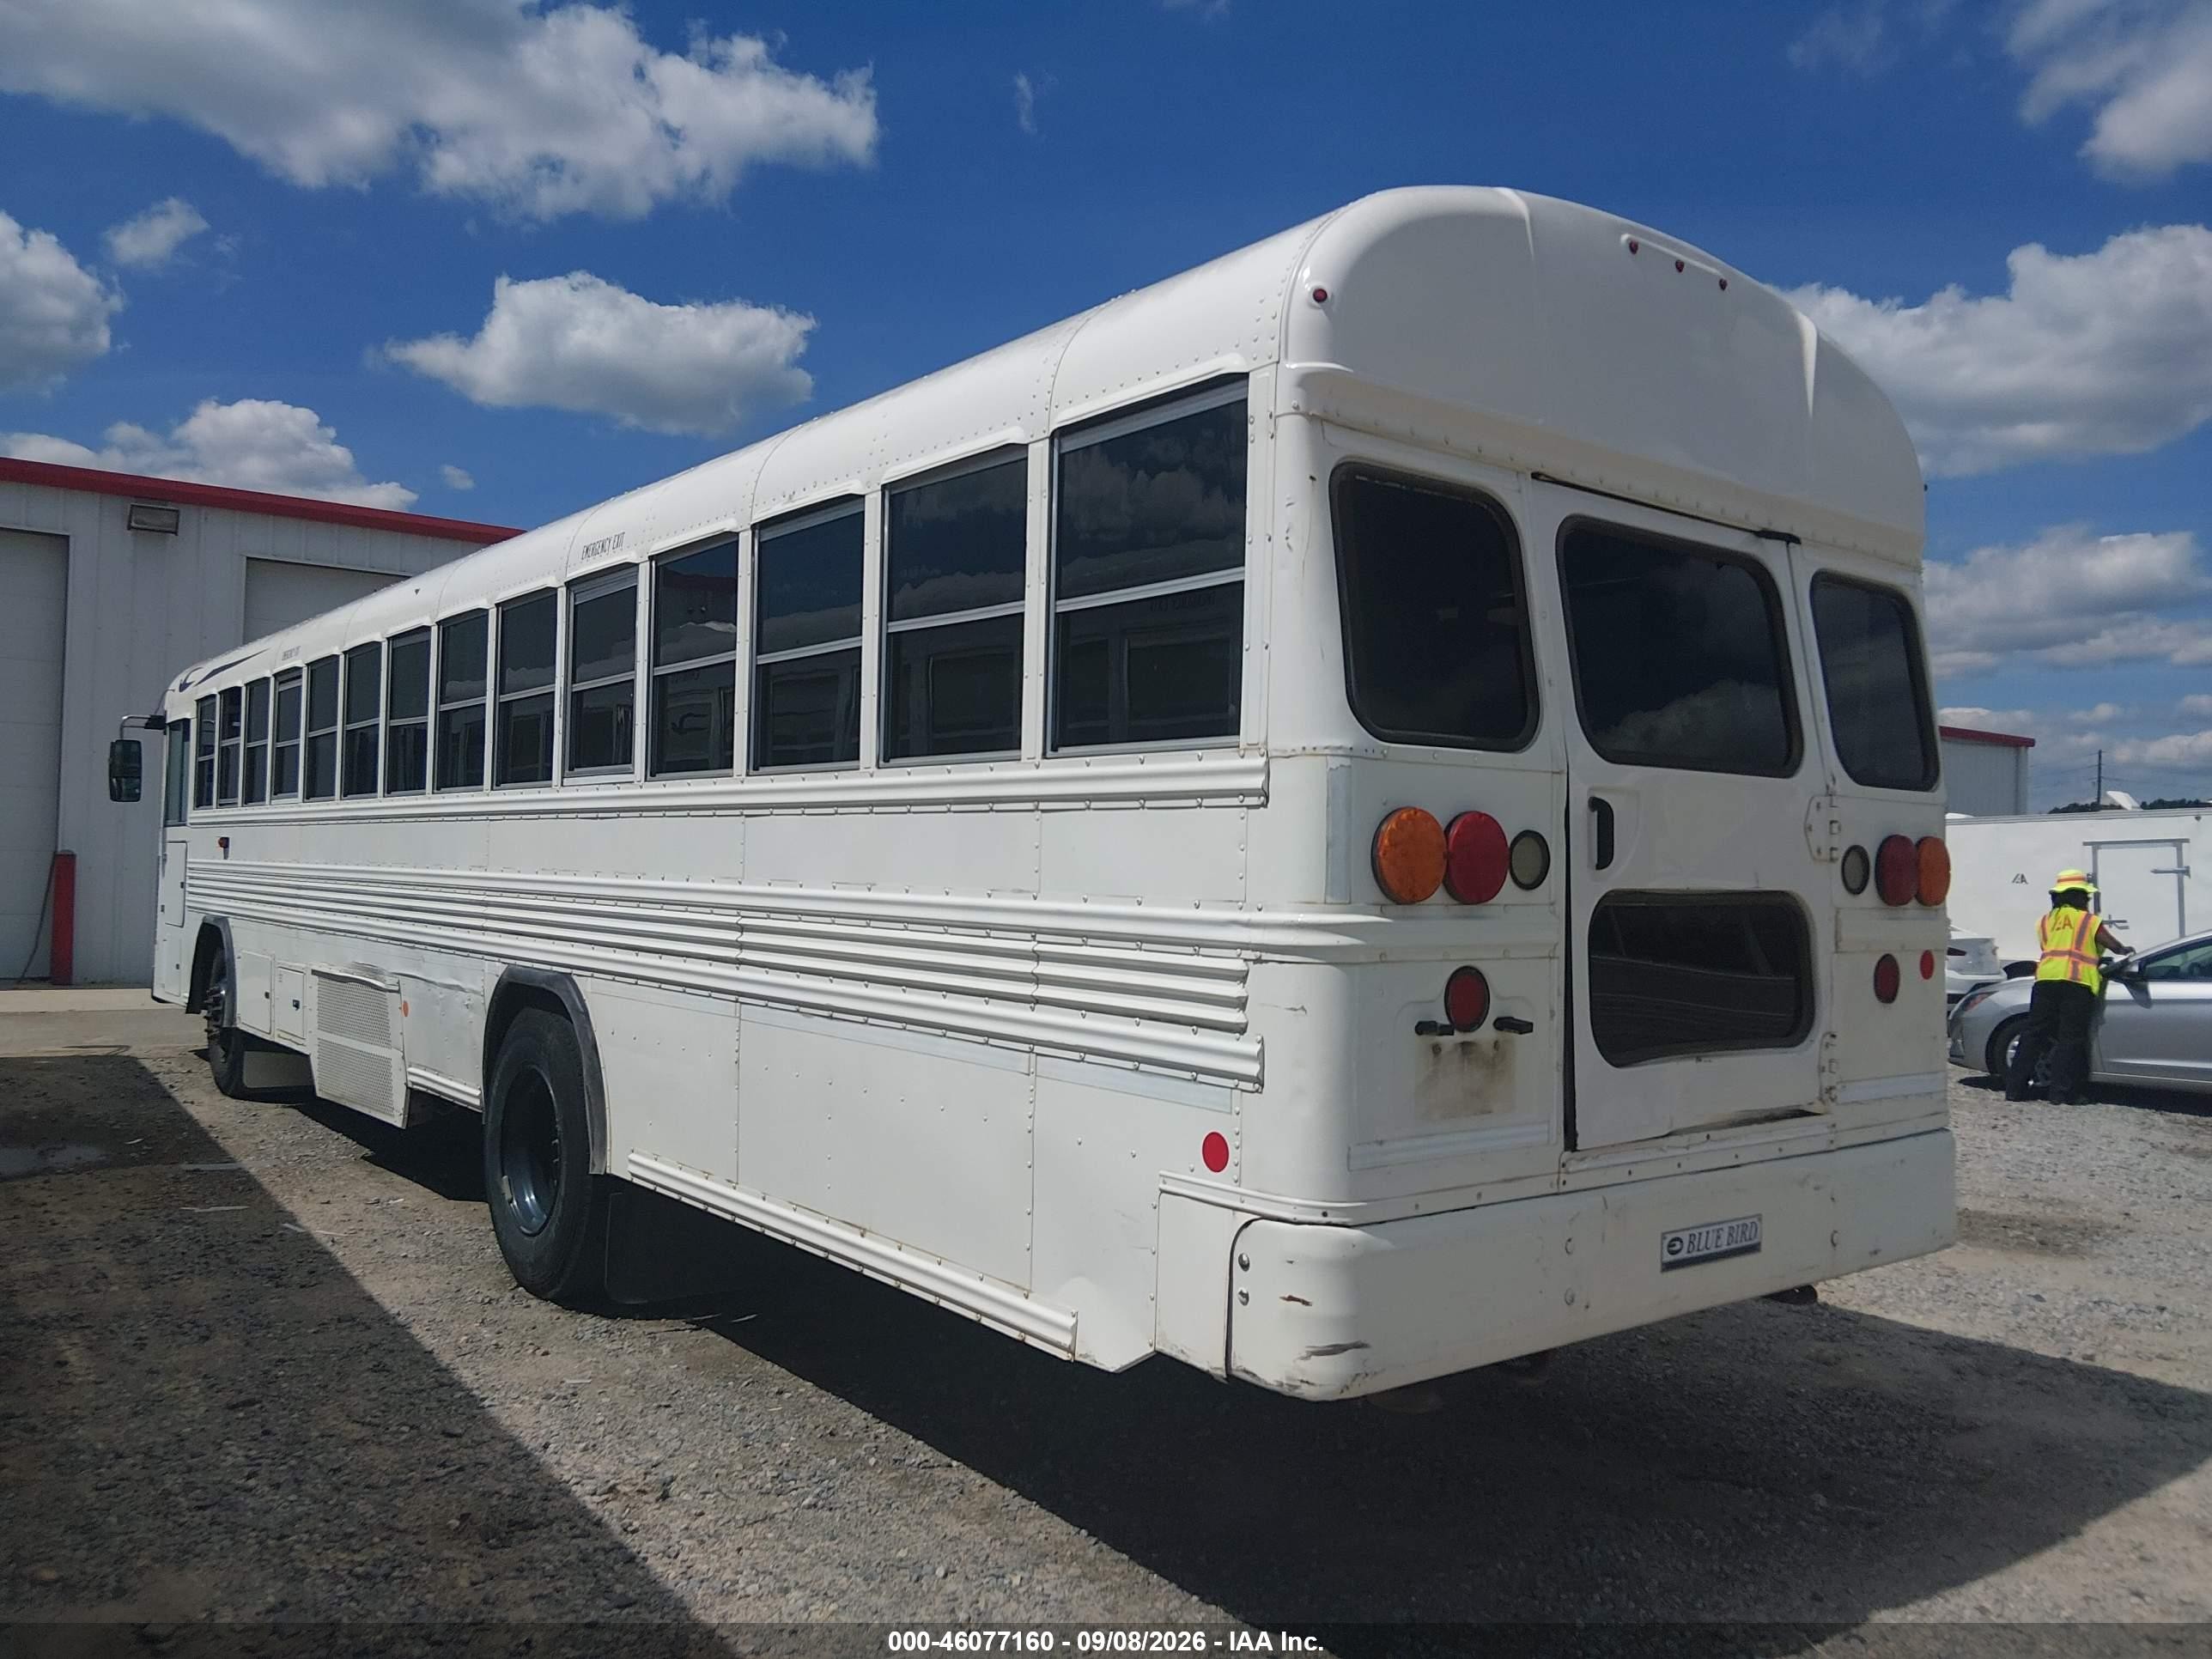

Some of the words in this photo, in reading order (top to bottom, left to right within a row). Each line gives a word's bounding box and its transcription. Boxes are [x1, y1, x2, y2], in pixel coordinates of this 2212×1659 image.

[581, 537, 611, 560] EMERGENCY
[612, 532, 625, 550] EXIT
[1687, 1228, 1724, 1254] BLUE
[1726, 1221, 1759, 1247] BIRD
